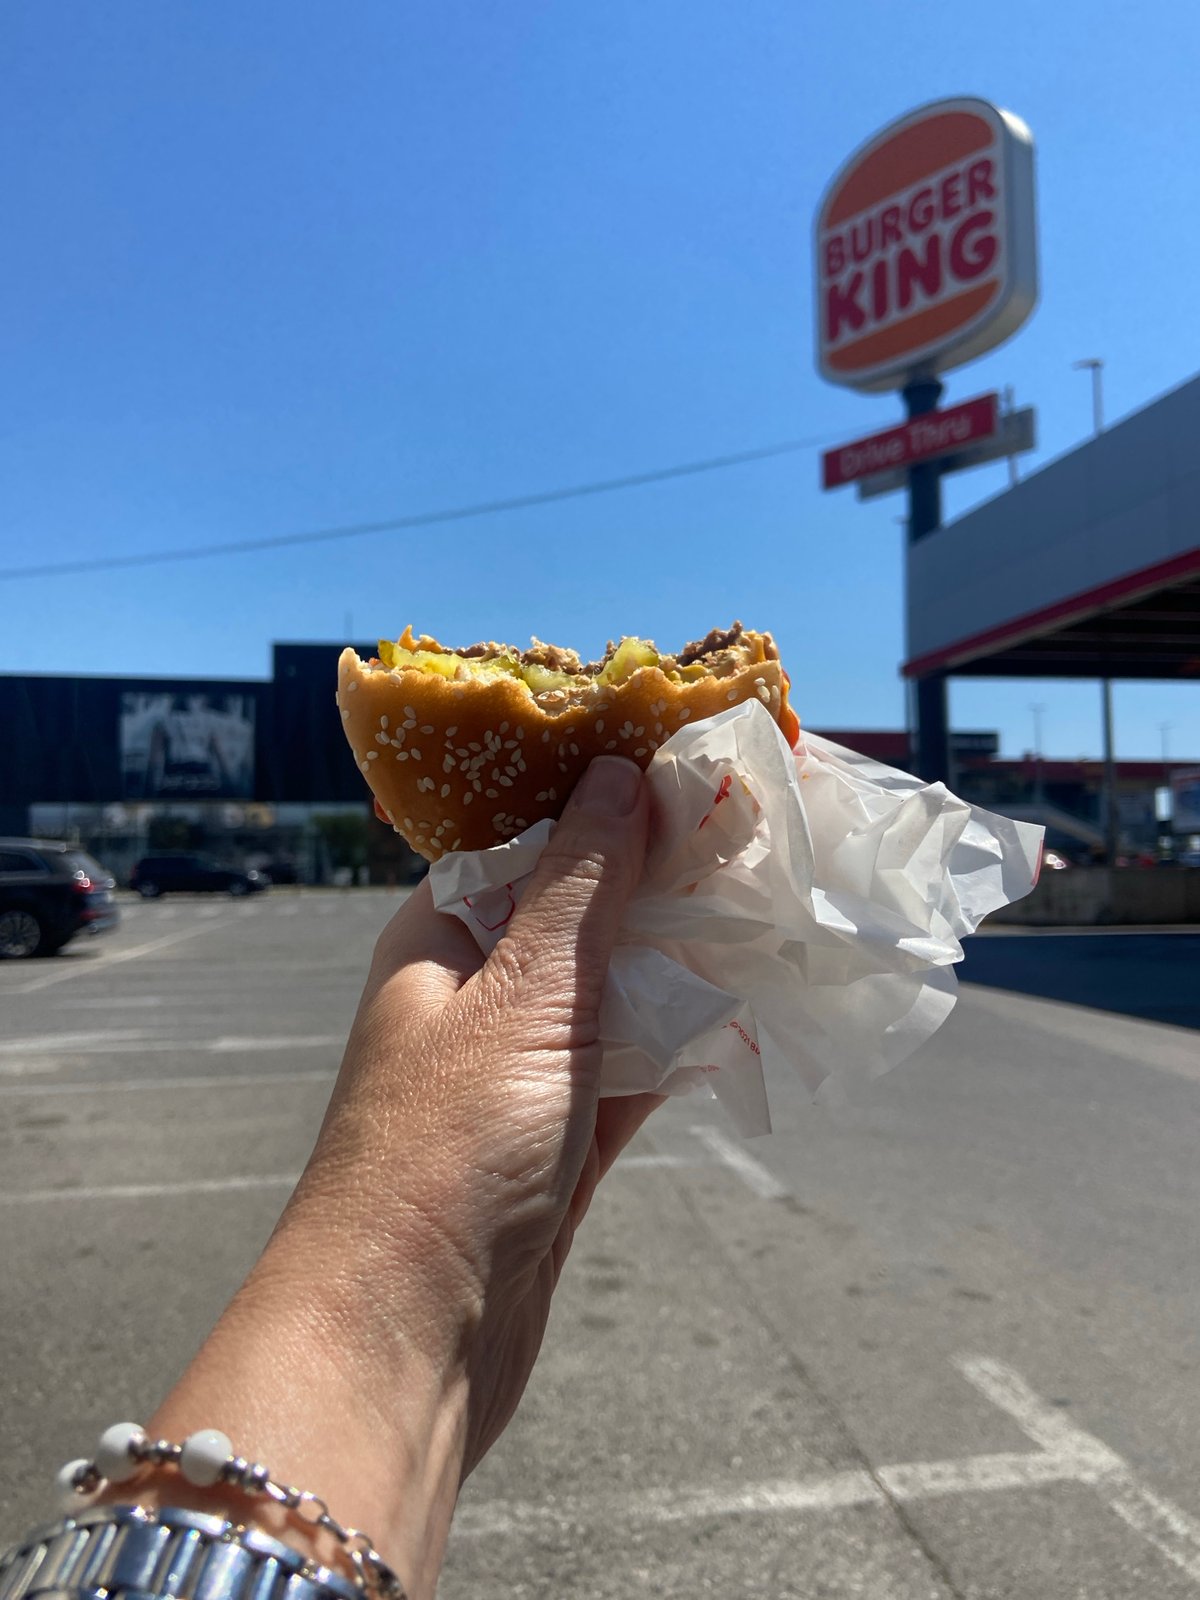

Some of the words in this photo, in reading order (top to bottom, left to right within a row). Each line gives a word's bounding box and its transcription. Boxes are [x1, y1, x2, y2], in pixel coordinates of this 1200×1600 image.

[826, 160, 996, 278] BURGER
[828, 211, 997, 342] KING
[840, 437, 904, 477] Drive
[910, 415, 972, 453] Thru
